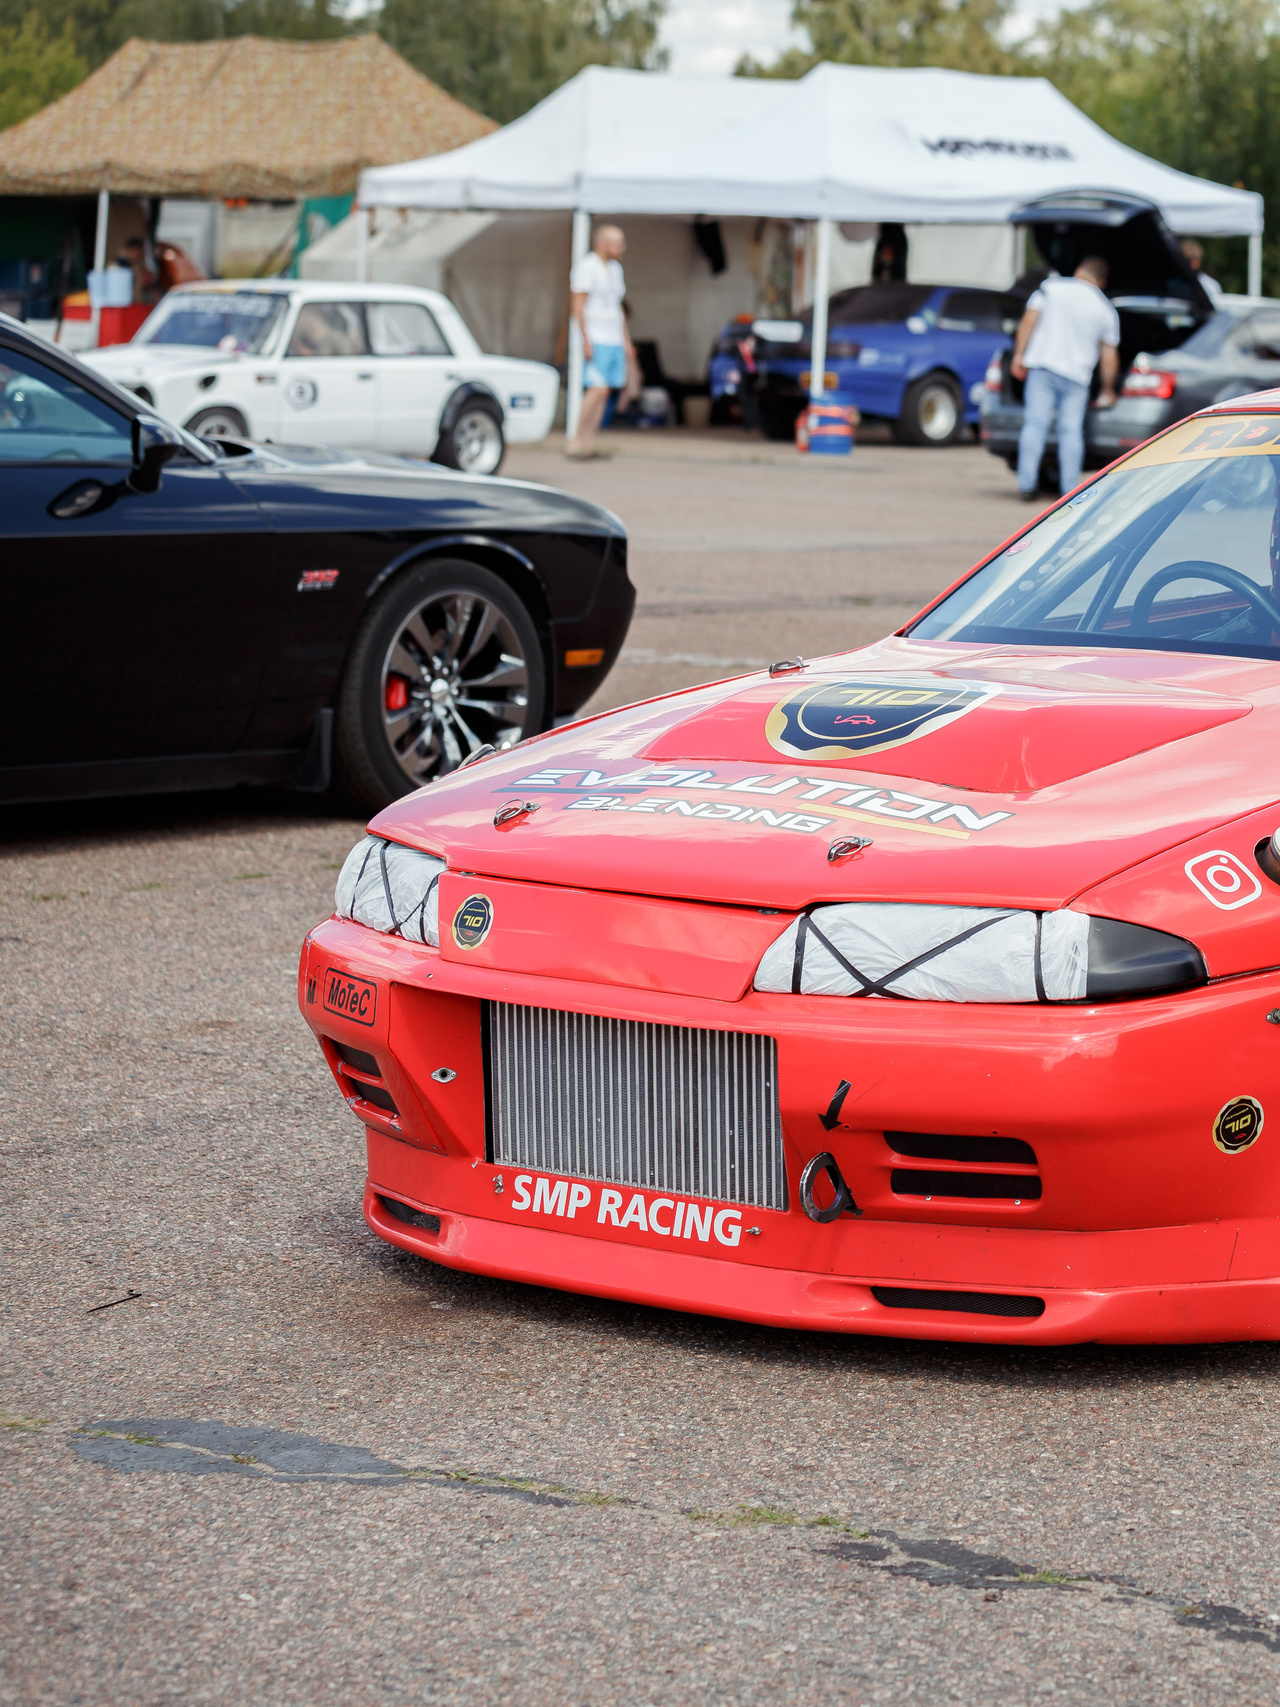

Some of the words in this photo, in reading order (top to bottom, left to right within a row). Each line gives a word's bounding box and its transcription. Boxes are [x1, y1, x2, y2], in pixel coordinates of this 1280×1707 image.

[509, 768, 1016, 831] EVOLUTION
[562, 795, 836, 834] BLENDING
[327, 977, 371, 1017] MoTeC
[511, 1174, 592, 1219] SMP
[597, 1188, 742, 1247] RACING
